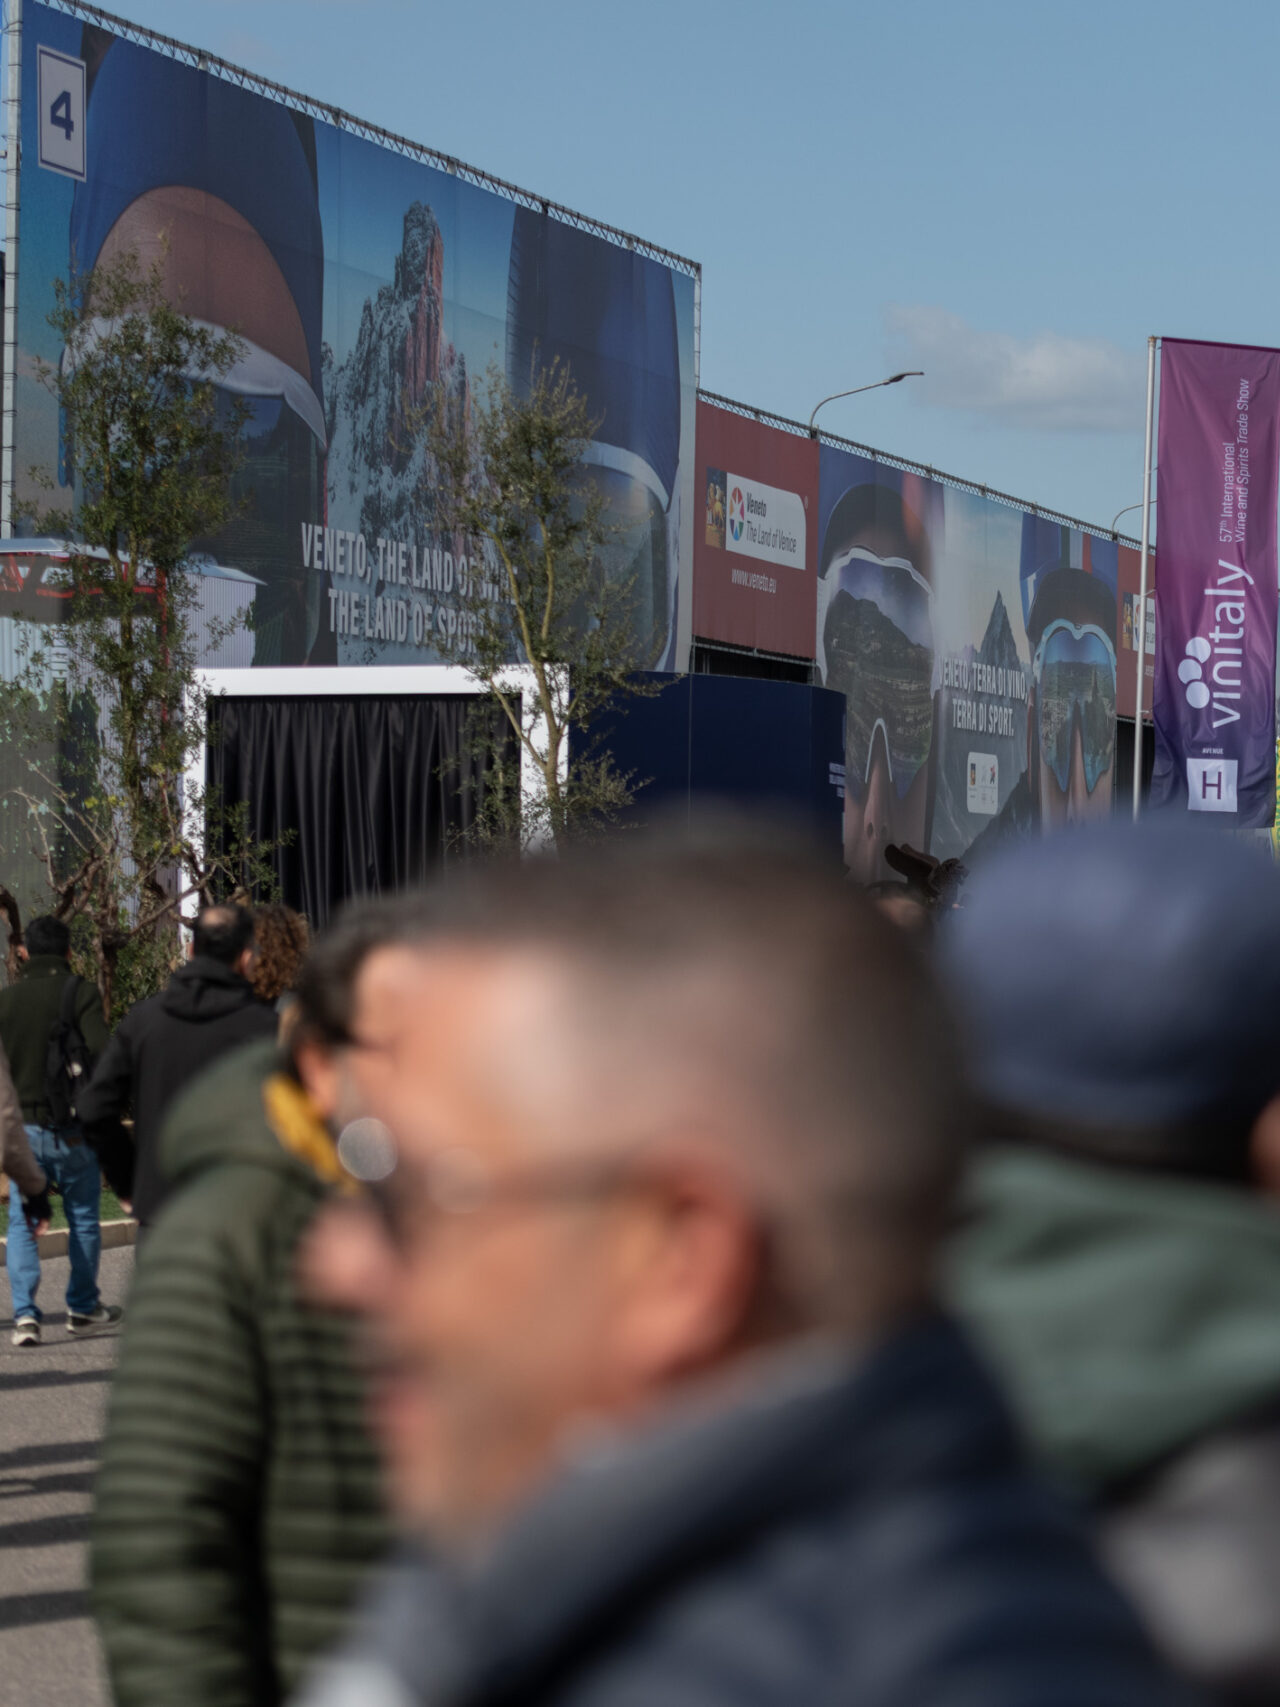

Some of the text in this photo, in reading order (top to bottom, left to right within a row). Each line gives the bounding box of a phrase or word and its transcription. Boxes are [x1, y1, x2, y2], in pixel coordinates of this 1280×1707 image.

[50, 90, 74, 141] 4
[1222, 442, 1235, 518] International
[1235, 378, 1252, 543] Wine and Spirits Trade Show
[746, 492, 767, 518] Veneto
[301, 522, 373, 585] VENETO,
[376, 537, 408, 586] THE
[411, 544, 453, 593] LAND
[746, 520, 797, 554] The Land of Venice
[731, 568, 777, 594] www.veneto.eu
[328, 587, 361, 636] THE
[364, 594, 409, 643] LAND
[412, 601, 434, 646] OF
[1204, 559, 1255, 729] vinitaly
[938, 656, 1029, 705] VENETO, TERRA DI VINO,
[952, 698, 1015, 737] TERRA DI SPORT.
[1202, 747, 1224, 755] AVENUE
[1202, 770, 1222, 800] H
